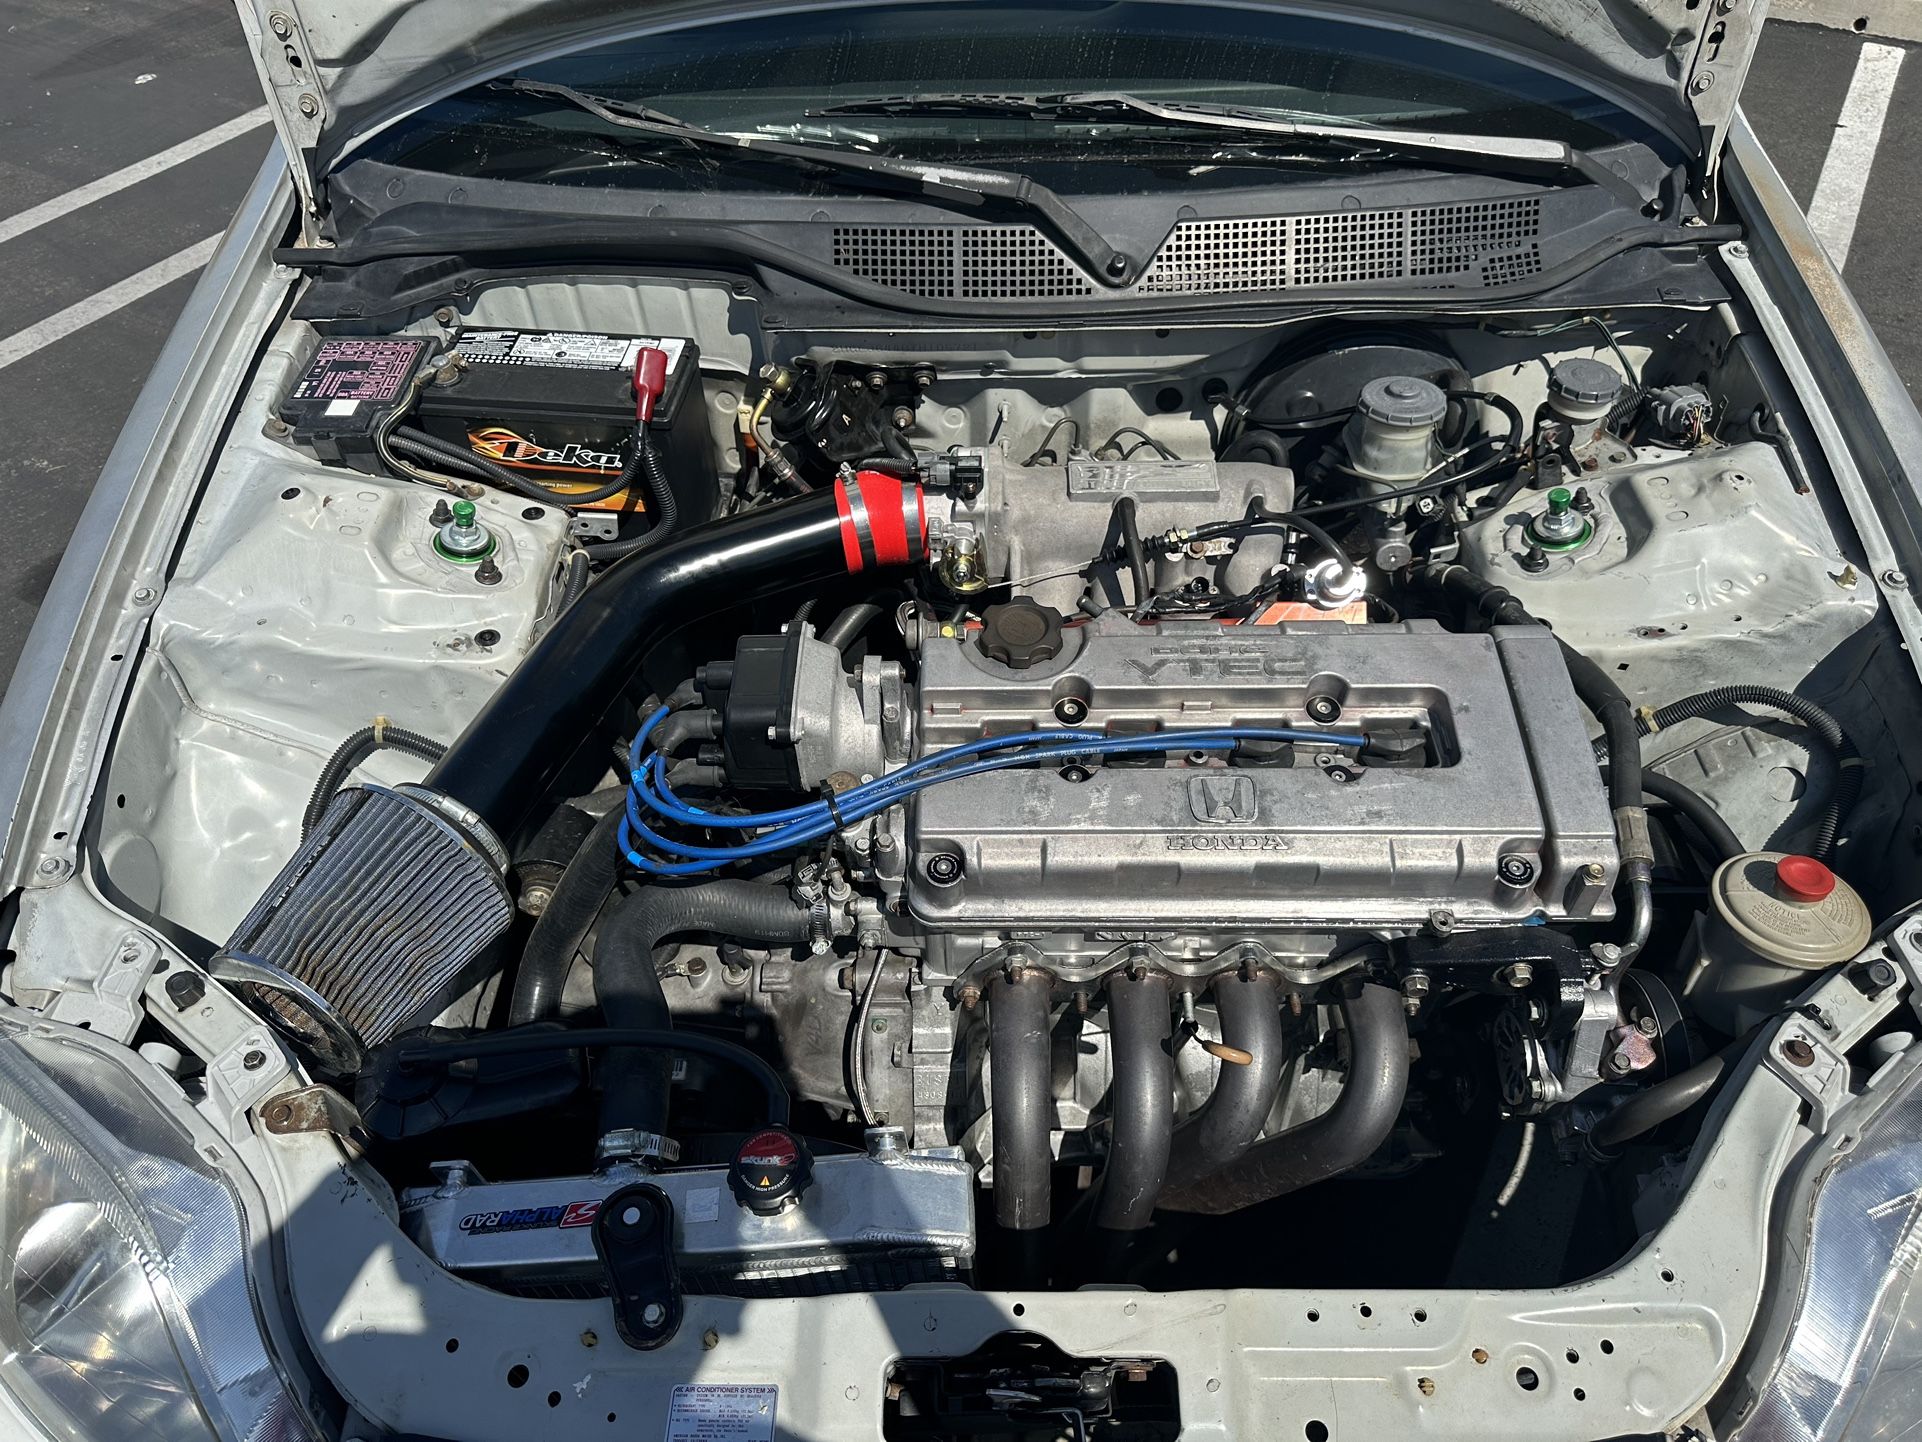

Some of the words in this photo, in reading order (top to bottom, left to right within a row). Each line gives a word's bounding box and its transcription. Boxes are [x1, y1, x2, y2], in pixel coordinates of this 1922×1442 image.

[500, 440, 621, 468] Deka
[1123, 658, 1308, 679] VTEC
[1034, 751, 1056, 759] SPARK
[1060, 749, 1077, 757] PLUG
[1081, 747, 1101, 755] CABLE
[1166, 834, 1289, 851] HONDA
[740, 1153, 796, 1167] skunk2
[768, 1173, 790, 1192] PRESSURE
[460, 1206, 564, 1230] ALPHARAD
